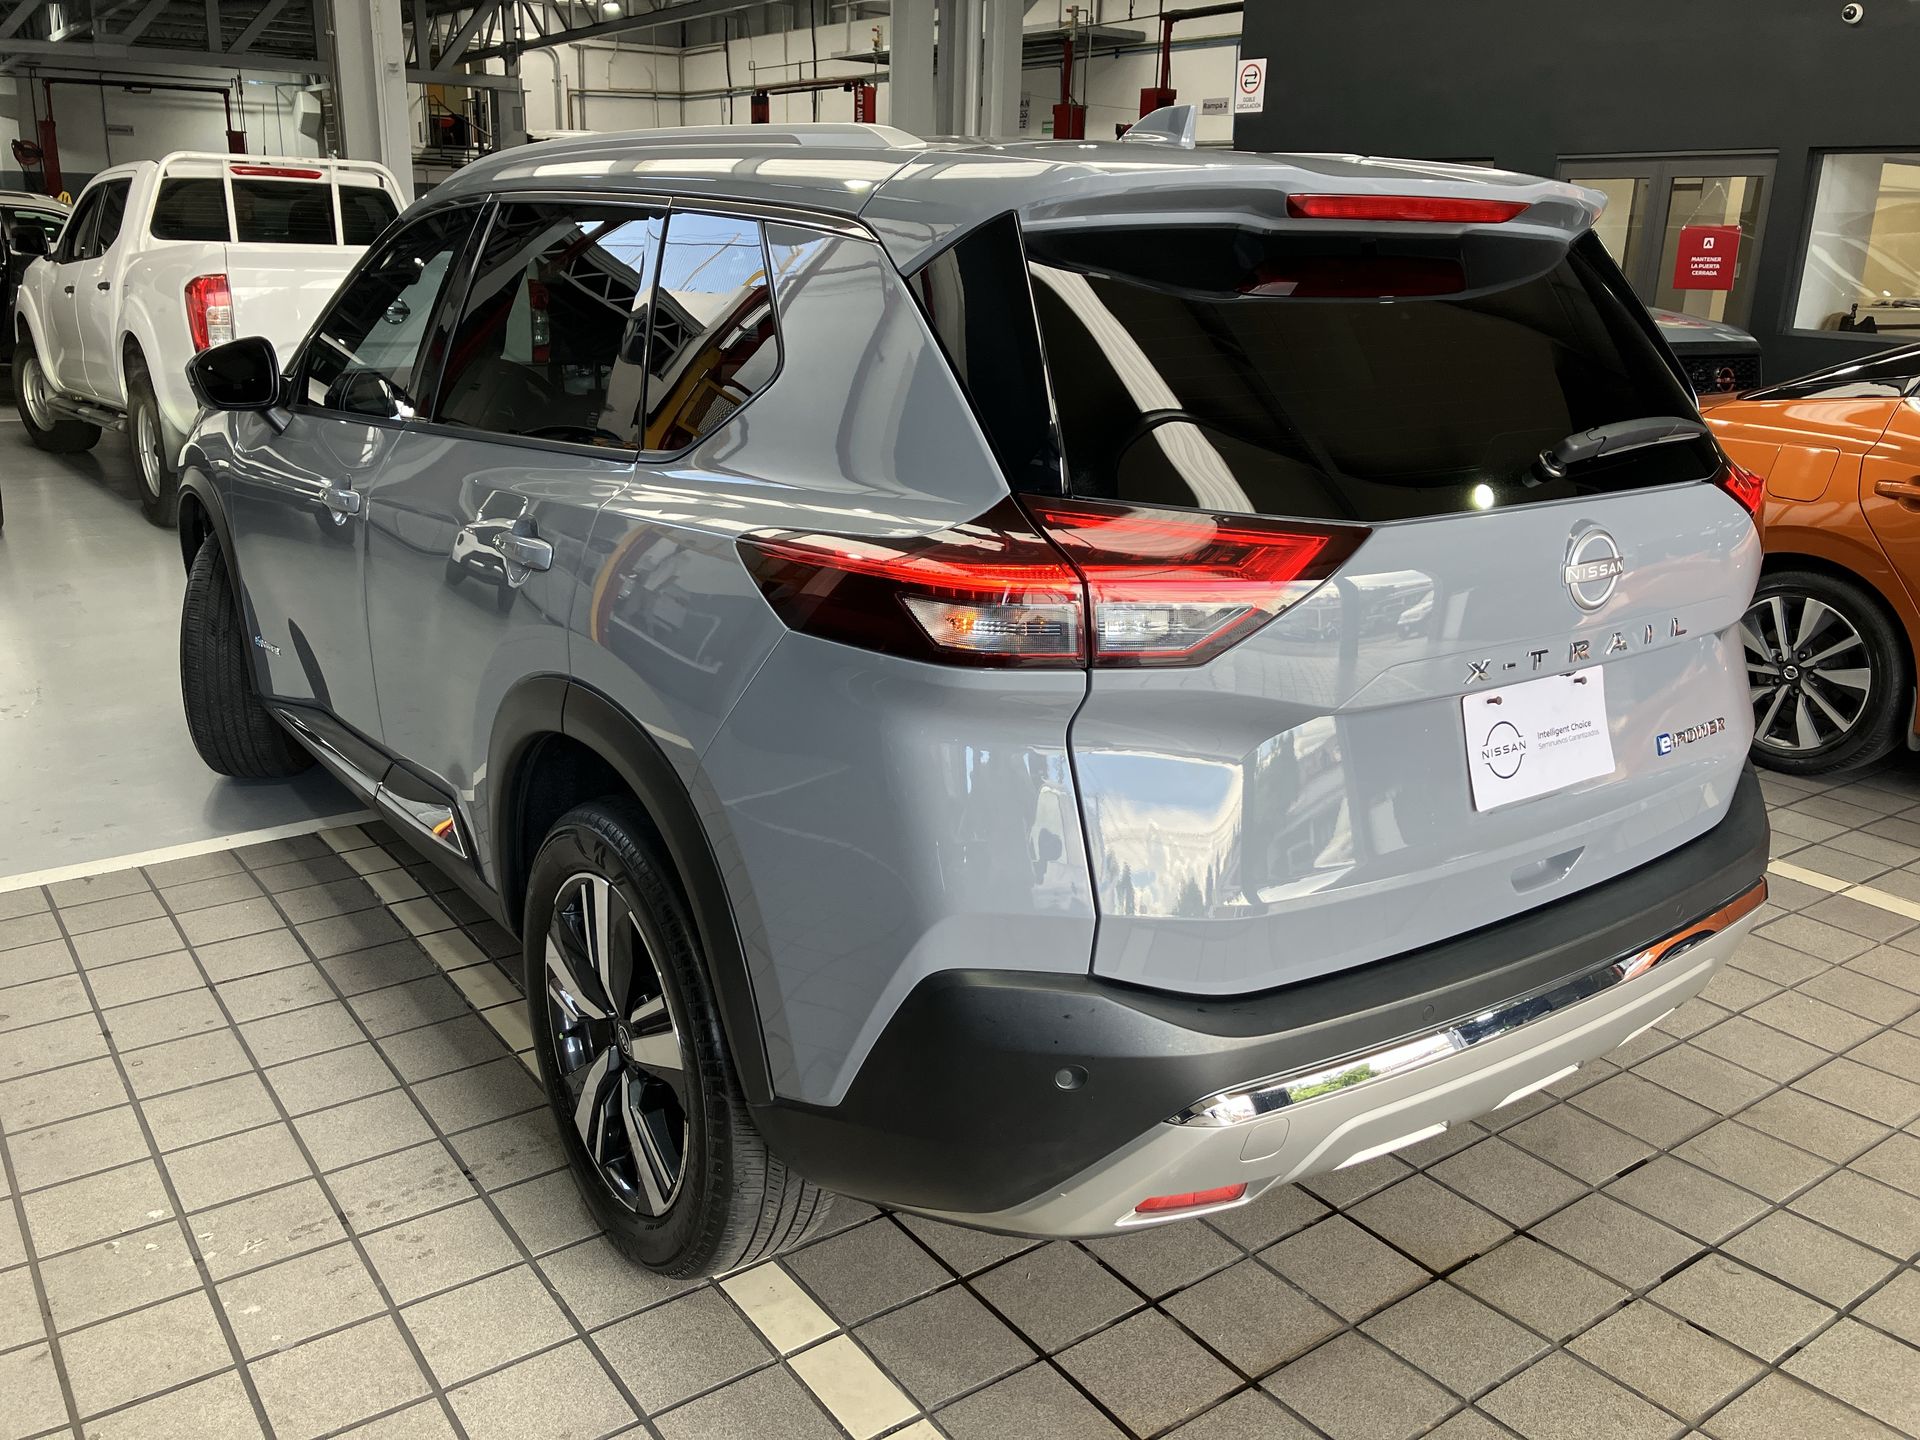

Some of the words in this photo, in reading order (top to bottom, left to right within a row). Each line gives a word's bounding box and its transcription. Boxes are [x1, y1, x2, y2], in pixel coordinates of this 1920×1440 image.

[1566, 559, 1624, 580] NISSAN
[1464, 617, 1687, 684] X-TRAIL
[1537, 724, 1570, 740] Intelligent
[1570, 719, 1592, 731] Choice
[1537, 735, 1568, 750] Seminuevos
[1568, 729, 1600, 742] Garantizados
[1481, 740, 1526, 760] NISSAN
